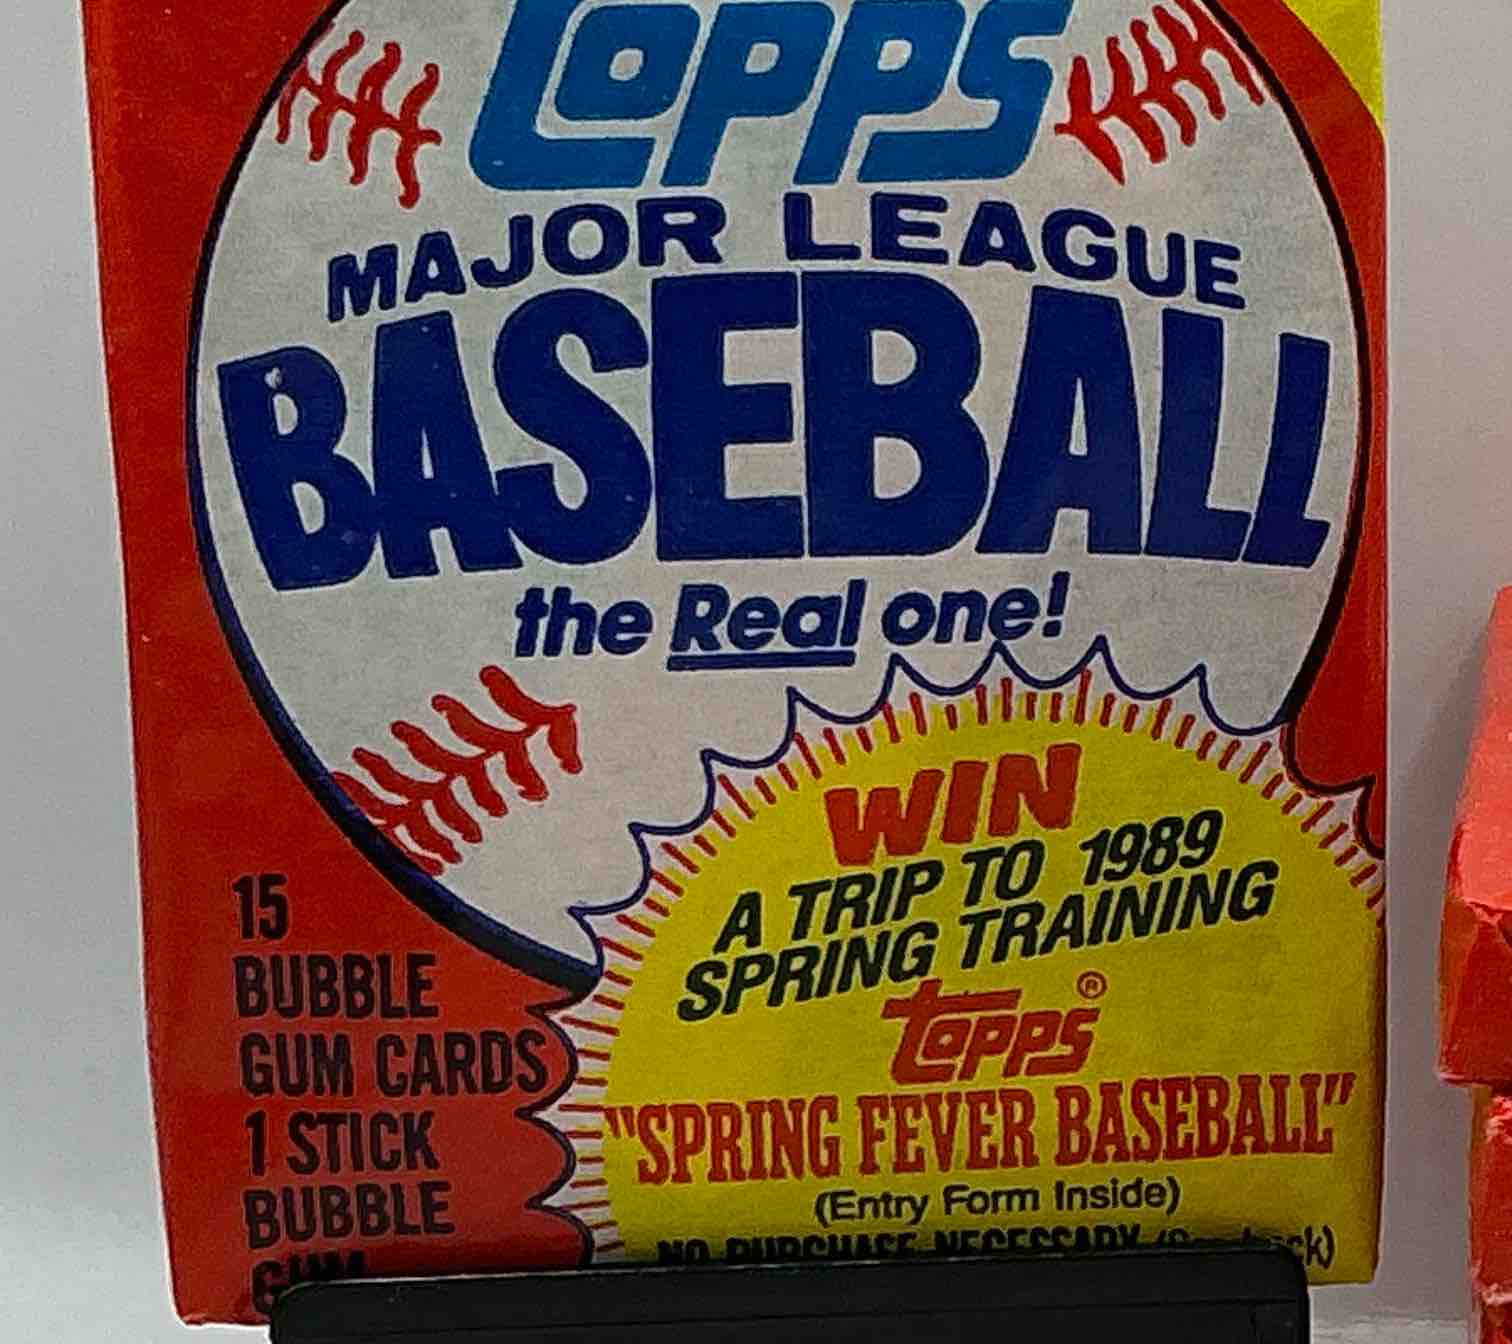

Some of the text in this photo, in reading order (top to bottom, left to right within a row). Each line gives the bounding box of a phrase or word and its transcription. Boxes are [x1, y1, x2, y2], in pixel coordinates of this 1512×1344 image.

[328, 193, 1245, 322] MAJOR LEAGUE
[217, 271, 1331, 591] BASEBALL
[513, 570, 1070, 662] the Real one!
[824, 743, 1082, 867] WIN
[232, 873, 288, 940] 15
[714, 809, 1223, 955] A TRIP TO 1989
[676, 859, 1280, 1021] SPRING TRAINING
[234, 954, 439, 1019] BUBBLE
[240, 1028, 548, 1097] GUM CARDS
[245, 1110, 440, 1176] 1 STICK
[604, 1071, 1355, 1185] "SPRING FEVER BASEBALL"
[244, 1181, 455, 1250] BUBBLE
[814, 1176, 1181, 1228] (Entry Form Inside)
